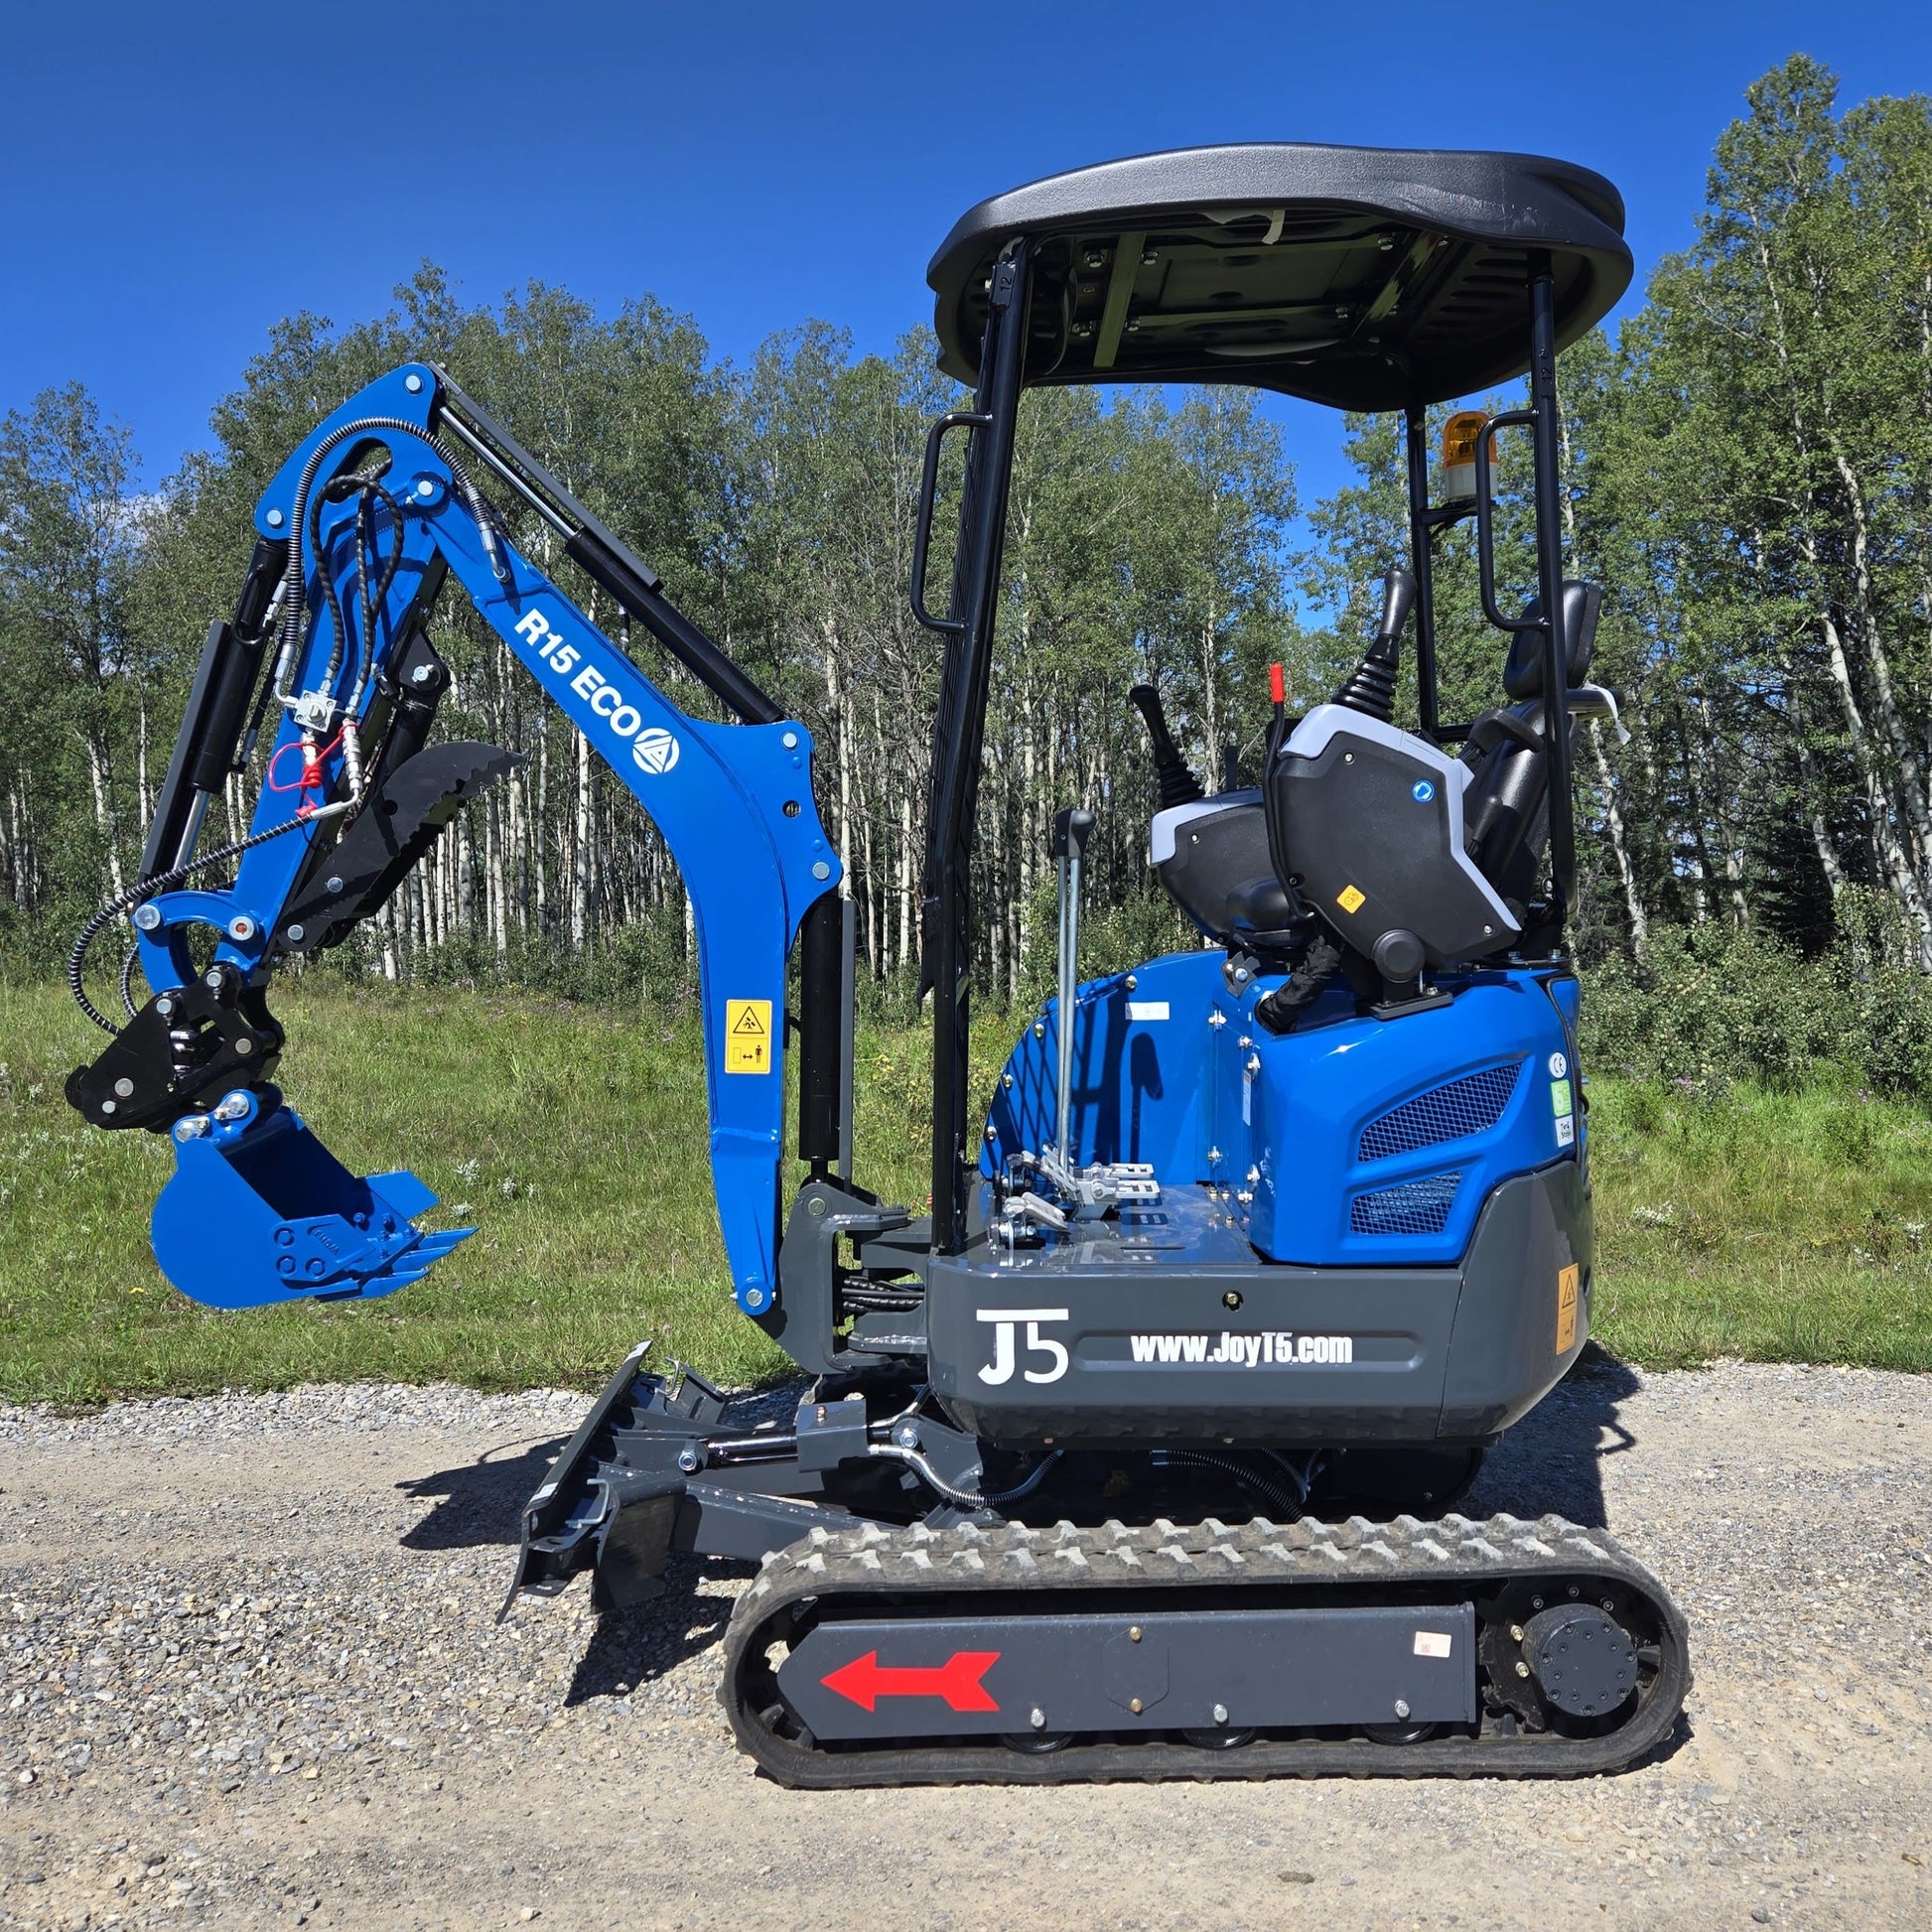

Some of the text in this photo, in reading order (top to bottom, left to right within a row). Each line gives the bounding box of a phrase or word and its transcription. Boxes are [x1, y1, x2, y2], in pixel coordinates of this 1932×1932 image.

[514, 608, 641, 737] R15 ECO
[1131, 1331, 1353, 1368] www.JoyT5.com
